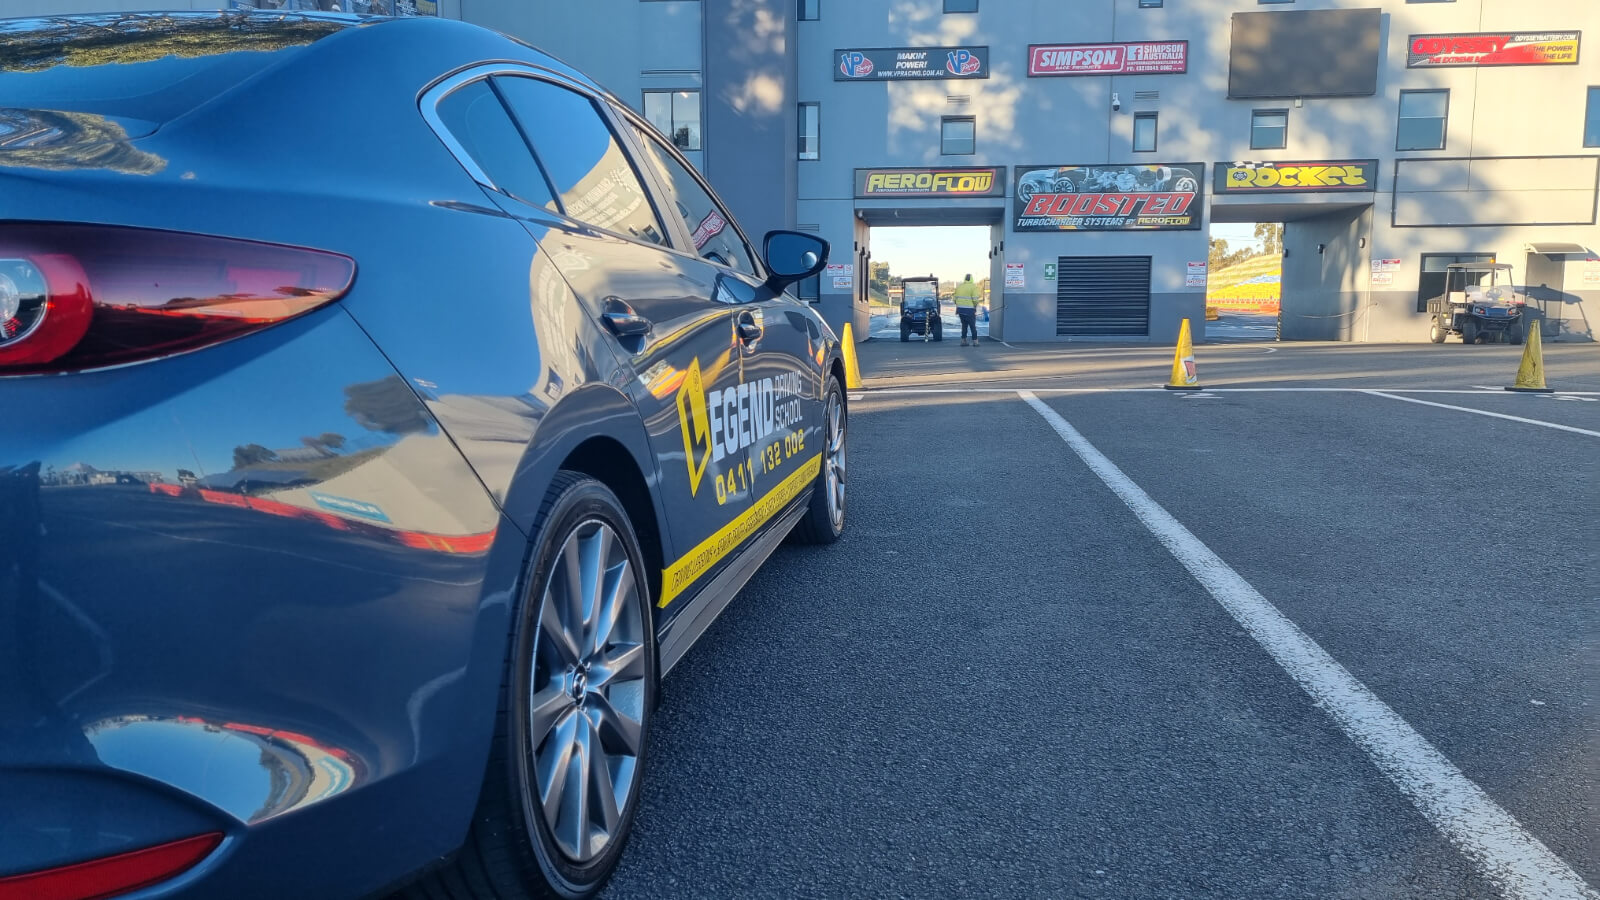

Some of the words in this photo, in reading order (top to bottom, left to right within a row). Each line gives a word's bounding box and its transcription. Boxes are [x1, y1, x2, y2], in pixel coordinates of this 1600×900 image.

[1144, 44, 1184, 53] SIMPSON
[1144, 52, 1184, 60] AUSTRALIA
[1412, 36, 1511, 55] ODYSSEY
[841, 52, 864, 77] VP
[896, 61, 928, 69] POWER!
[947, 50, 970, 73] VP
[1039, 50, 1117, 67] SIMPSON
[867, 172, 993, 193] AEROFLOW
[1021, 192, 1197, 217] BOOSTED
[1017, 217, 1082, 226] TURBOCHARGER
[1084, 217, 1124, 225] SYSTEMS
[1137, 216, 1191, 225] AEROFLOW
[775, 370, 802, 400] DRIVING
[775, 398, 803, 431] SCHOOL
[715, 457, 754, 506] 0411
[760, 441, 782, 475] 132
[785, 428, 805, 459] 002
